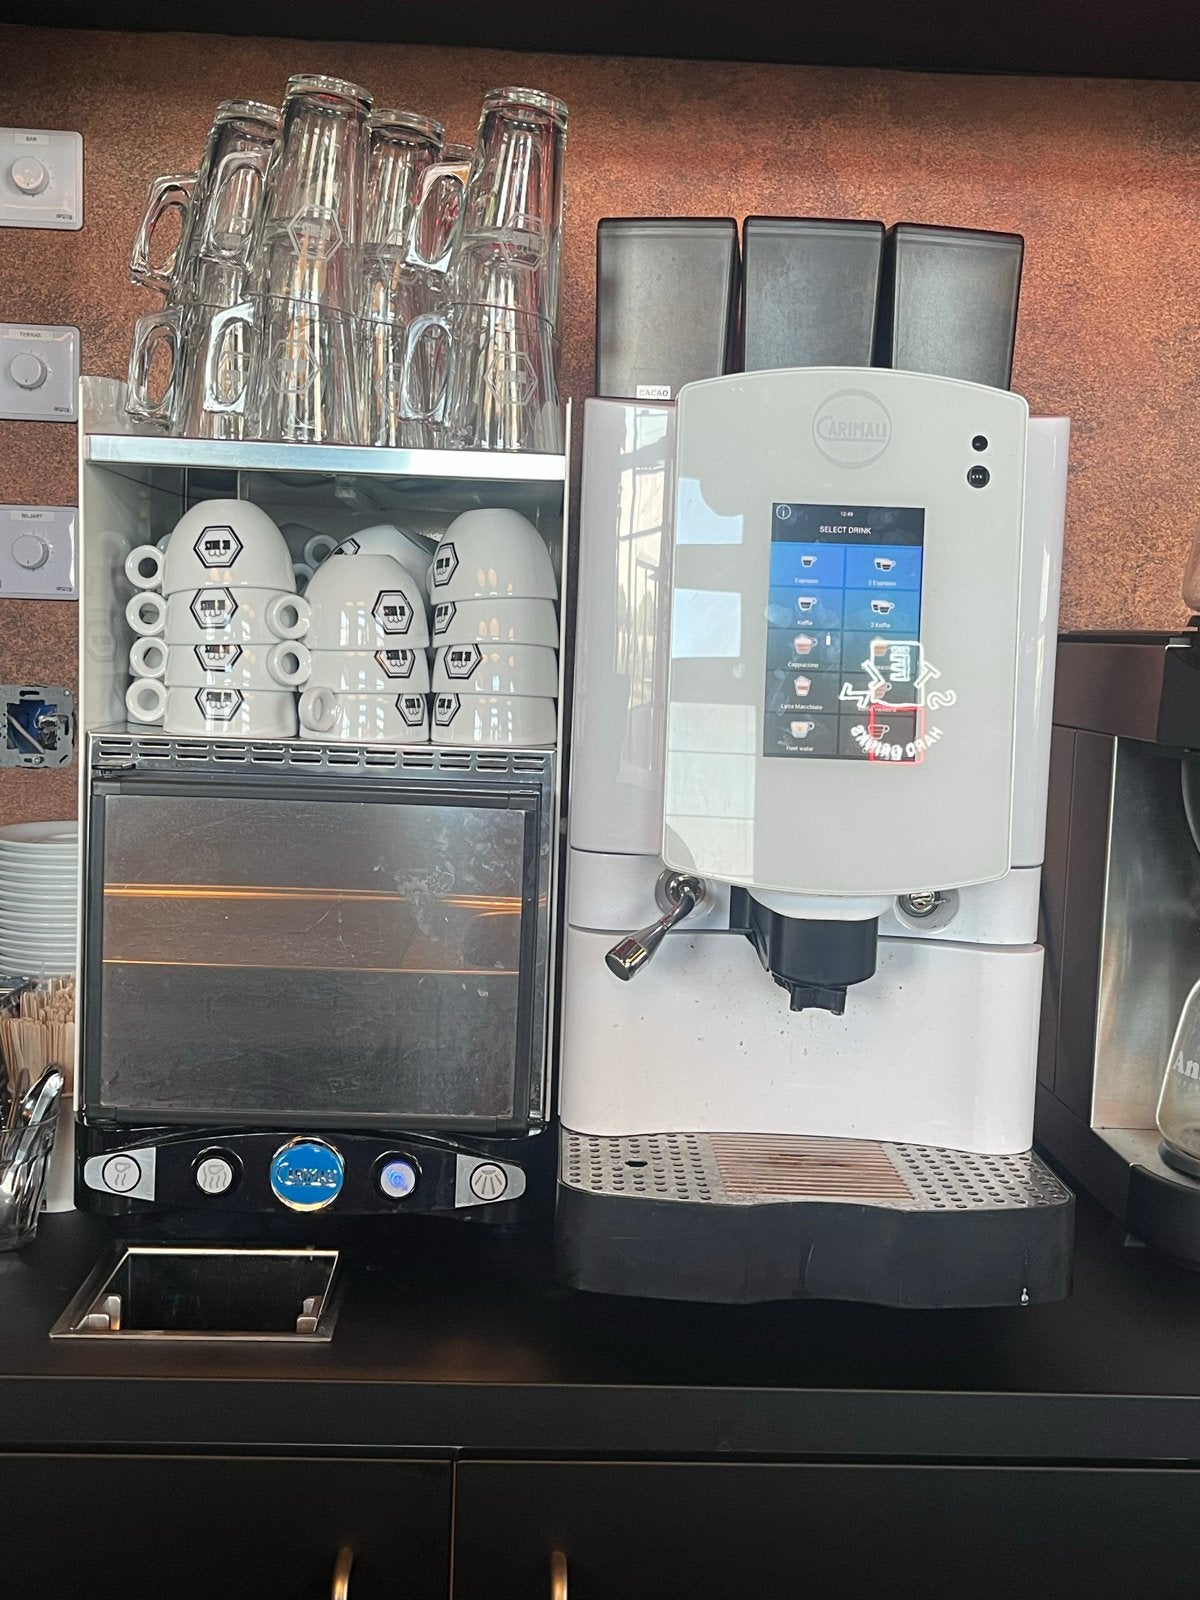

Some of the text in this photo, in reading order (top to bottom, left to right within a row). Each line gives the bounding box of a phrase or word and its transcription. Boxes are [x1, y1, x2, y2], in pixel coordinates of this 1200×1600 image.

[640, 389, 669, 397] CACAO
[816, 415, 887, 443] CARIMALI
[819, 525, 872, 535] SELECT DRINK
[794, 577, 819, 585] Espresso
[787, 661, 819, 670] Cappuccino
[1173, 1050, 1200, 1080] An
